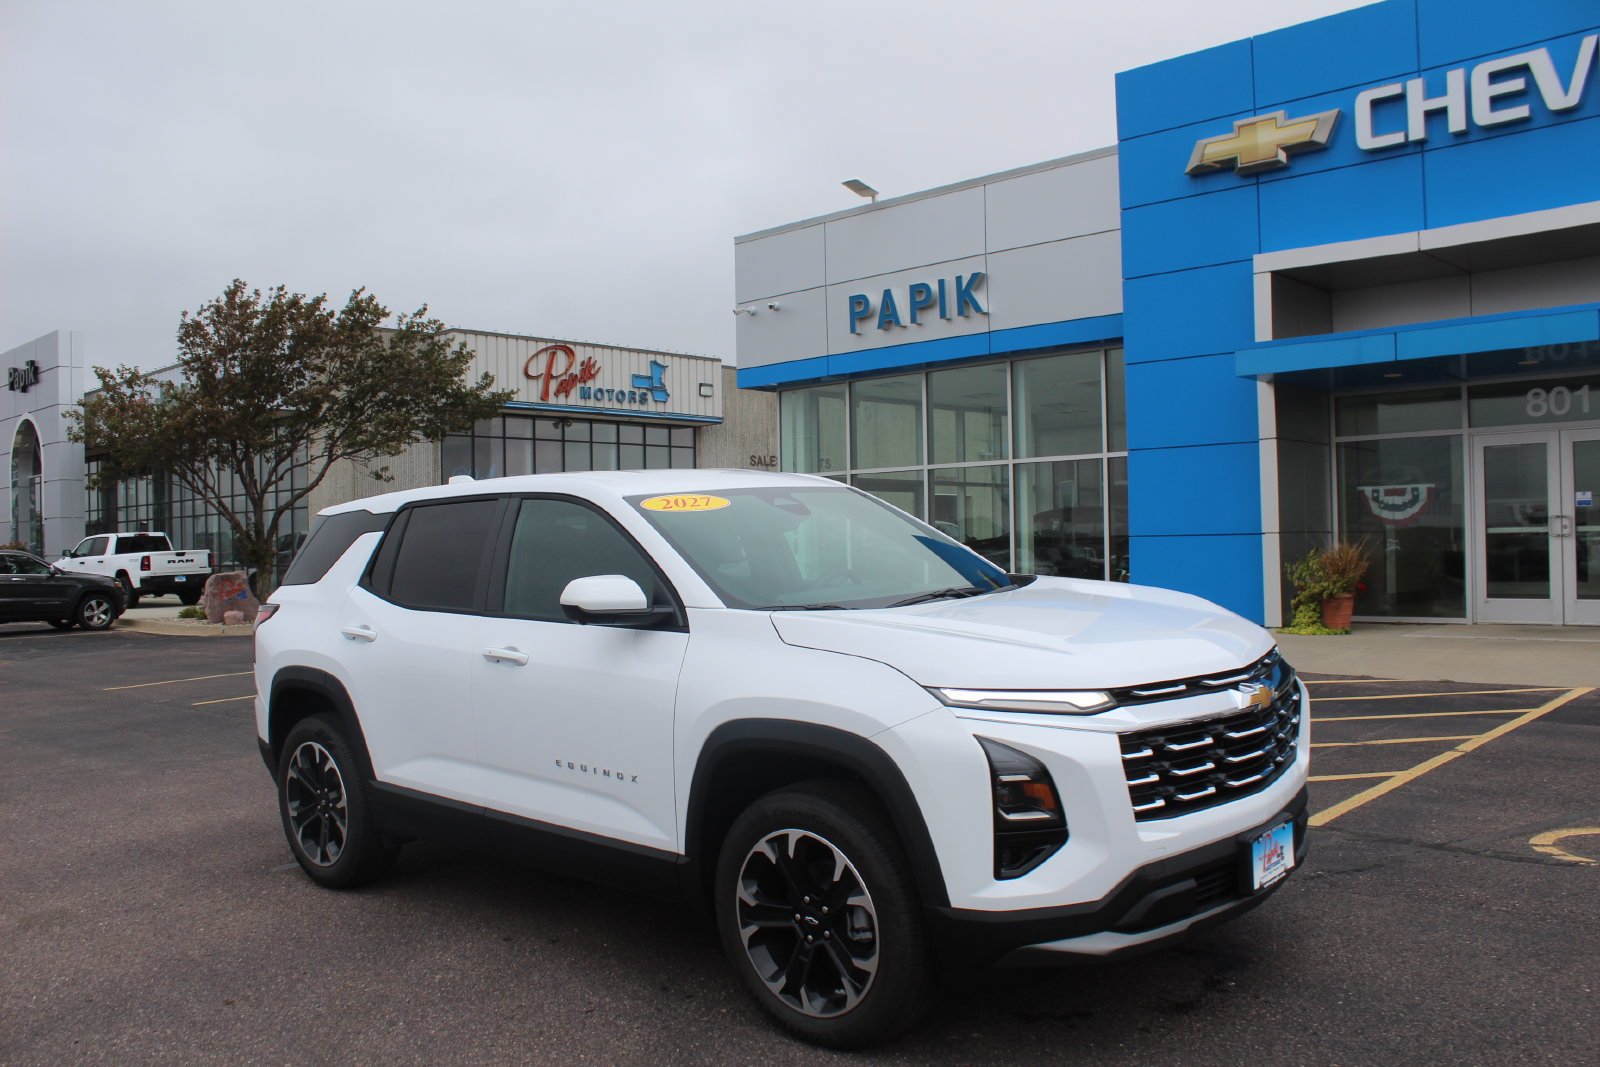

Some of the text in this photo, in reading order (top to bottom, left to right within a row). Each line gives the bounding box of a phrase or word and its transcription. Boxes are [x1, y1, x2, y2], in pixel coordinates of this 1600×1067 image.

[1355, 34, 1600, 151] CHEV
[849, 272, 989, 335] PAPIK
[8, 359, 40, 393] Papik
[523, 344, 601, 401] Papik
[579, 386, 649, 403] MOTORS
[1526, 384, 1590, 417] 801
[750, 454, 777, 467] SALE
[660, 497, 711, 510] 2027
[555, 759, 639, 783] EQUINOX
